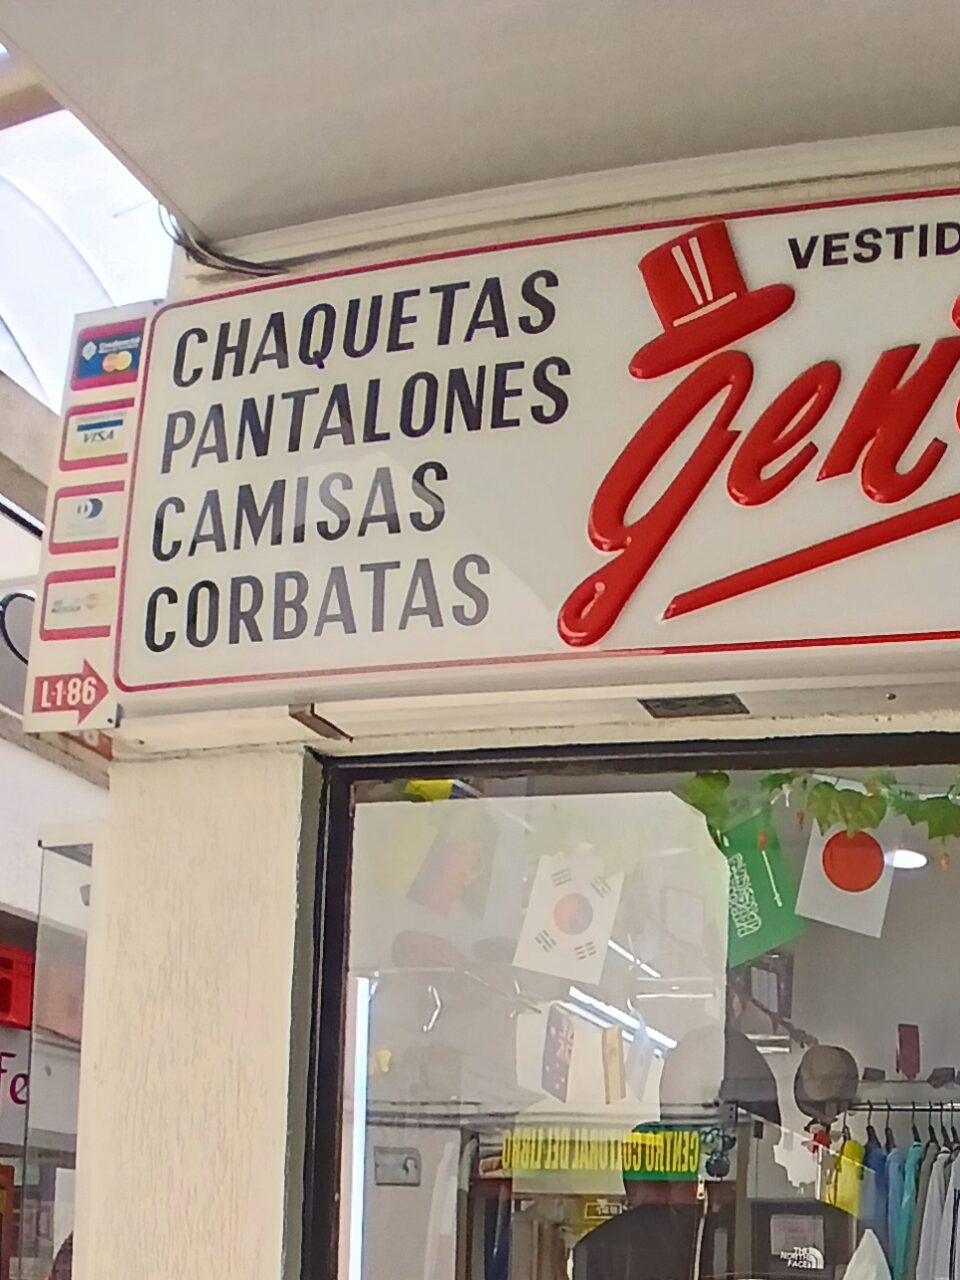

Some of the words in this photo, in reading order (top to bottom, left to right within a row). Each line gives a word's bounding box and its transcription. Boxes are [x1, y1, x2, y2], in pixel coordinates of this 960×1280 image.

[173, 269, 559, 388] CHAQUETAS
[160, 356, 572, 475] PANTALONES
[151, 461, 448, 562] CAMISAS
[144, 553, 490, 653] CORBATAS
